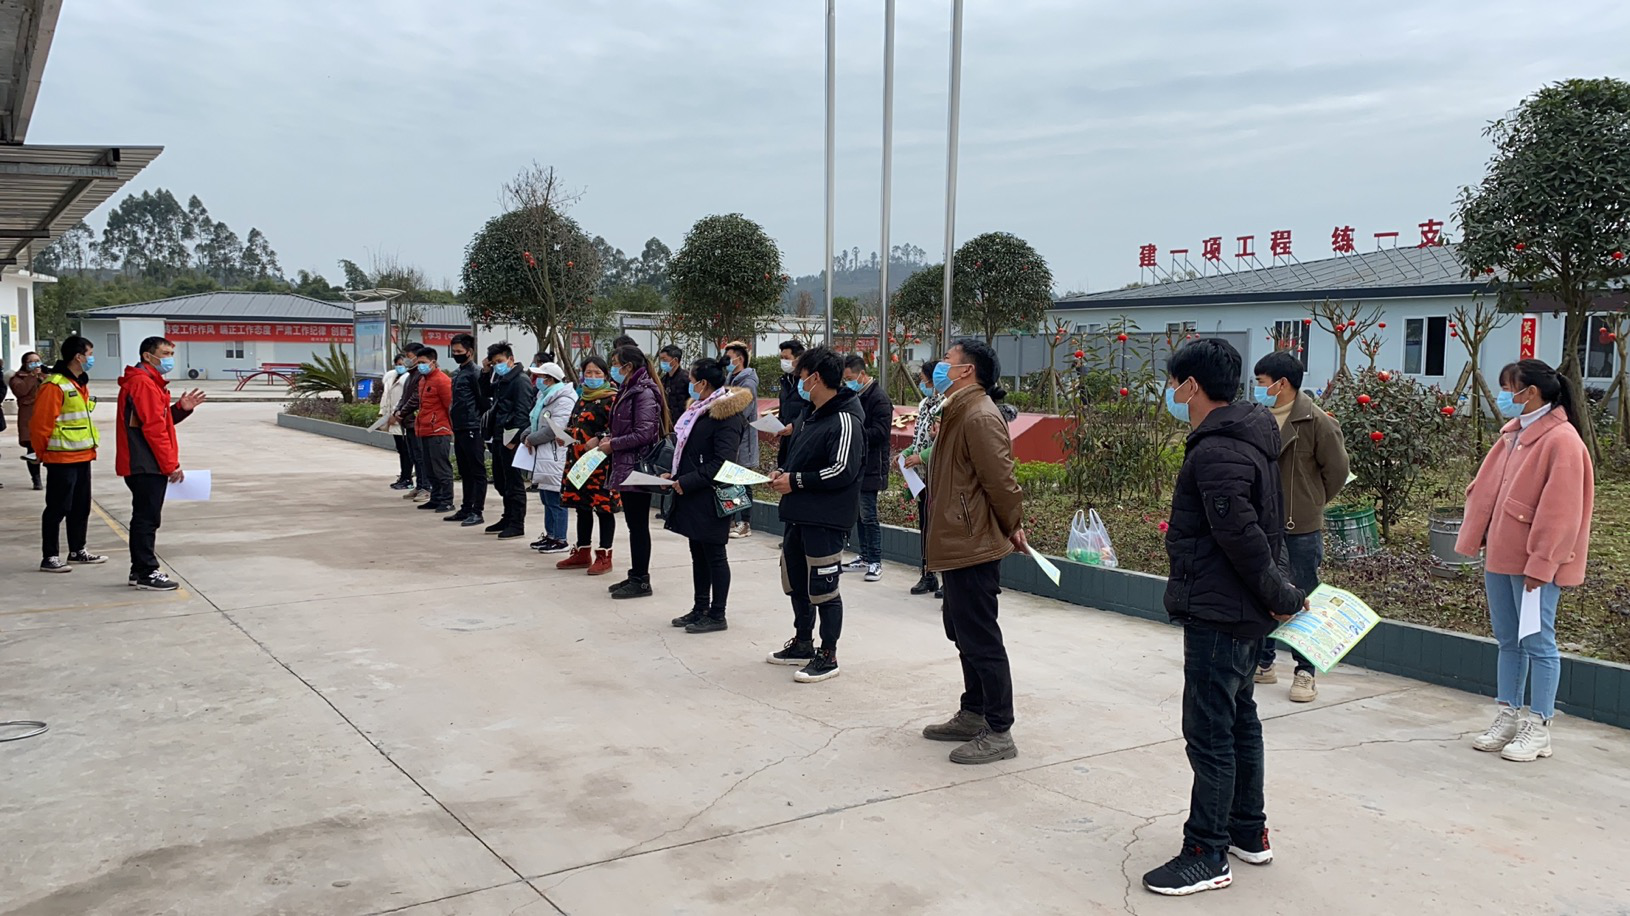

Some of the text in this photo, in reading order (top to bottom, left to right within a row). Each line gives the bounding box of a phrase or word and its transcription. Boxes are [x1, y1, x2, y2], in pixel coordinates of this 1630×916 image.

[1138, 218, 1444, 268] 建一项工程 练一支
[219, 324, 272, 335] 端正工作态度
[275, 325, 327, 336] 严肃工作纪律
